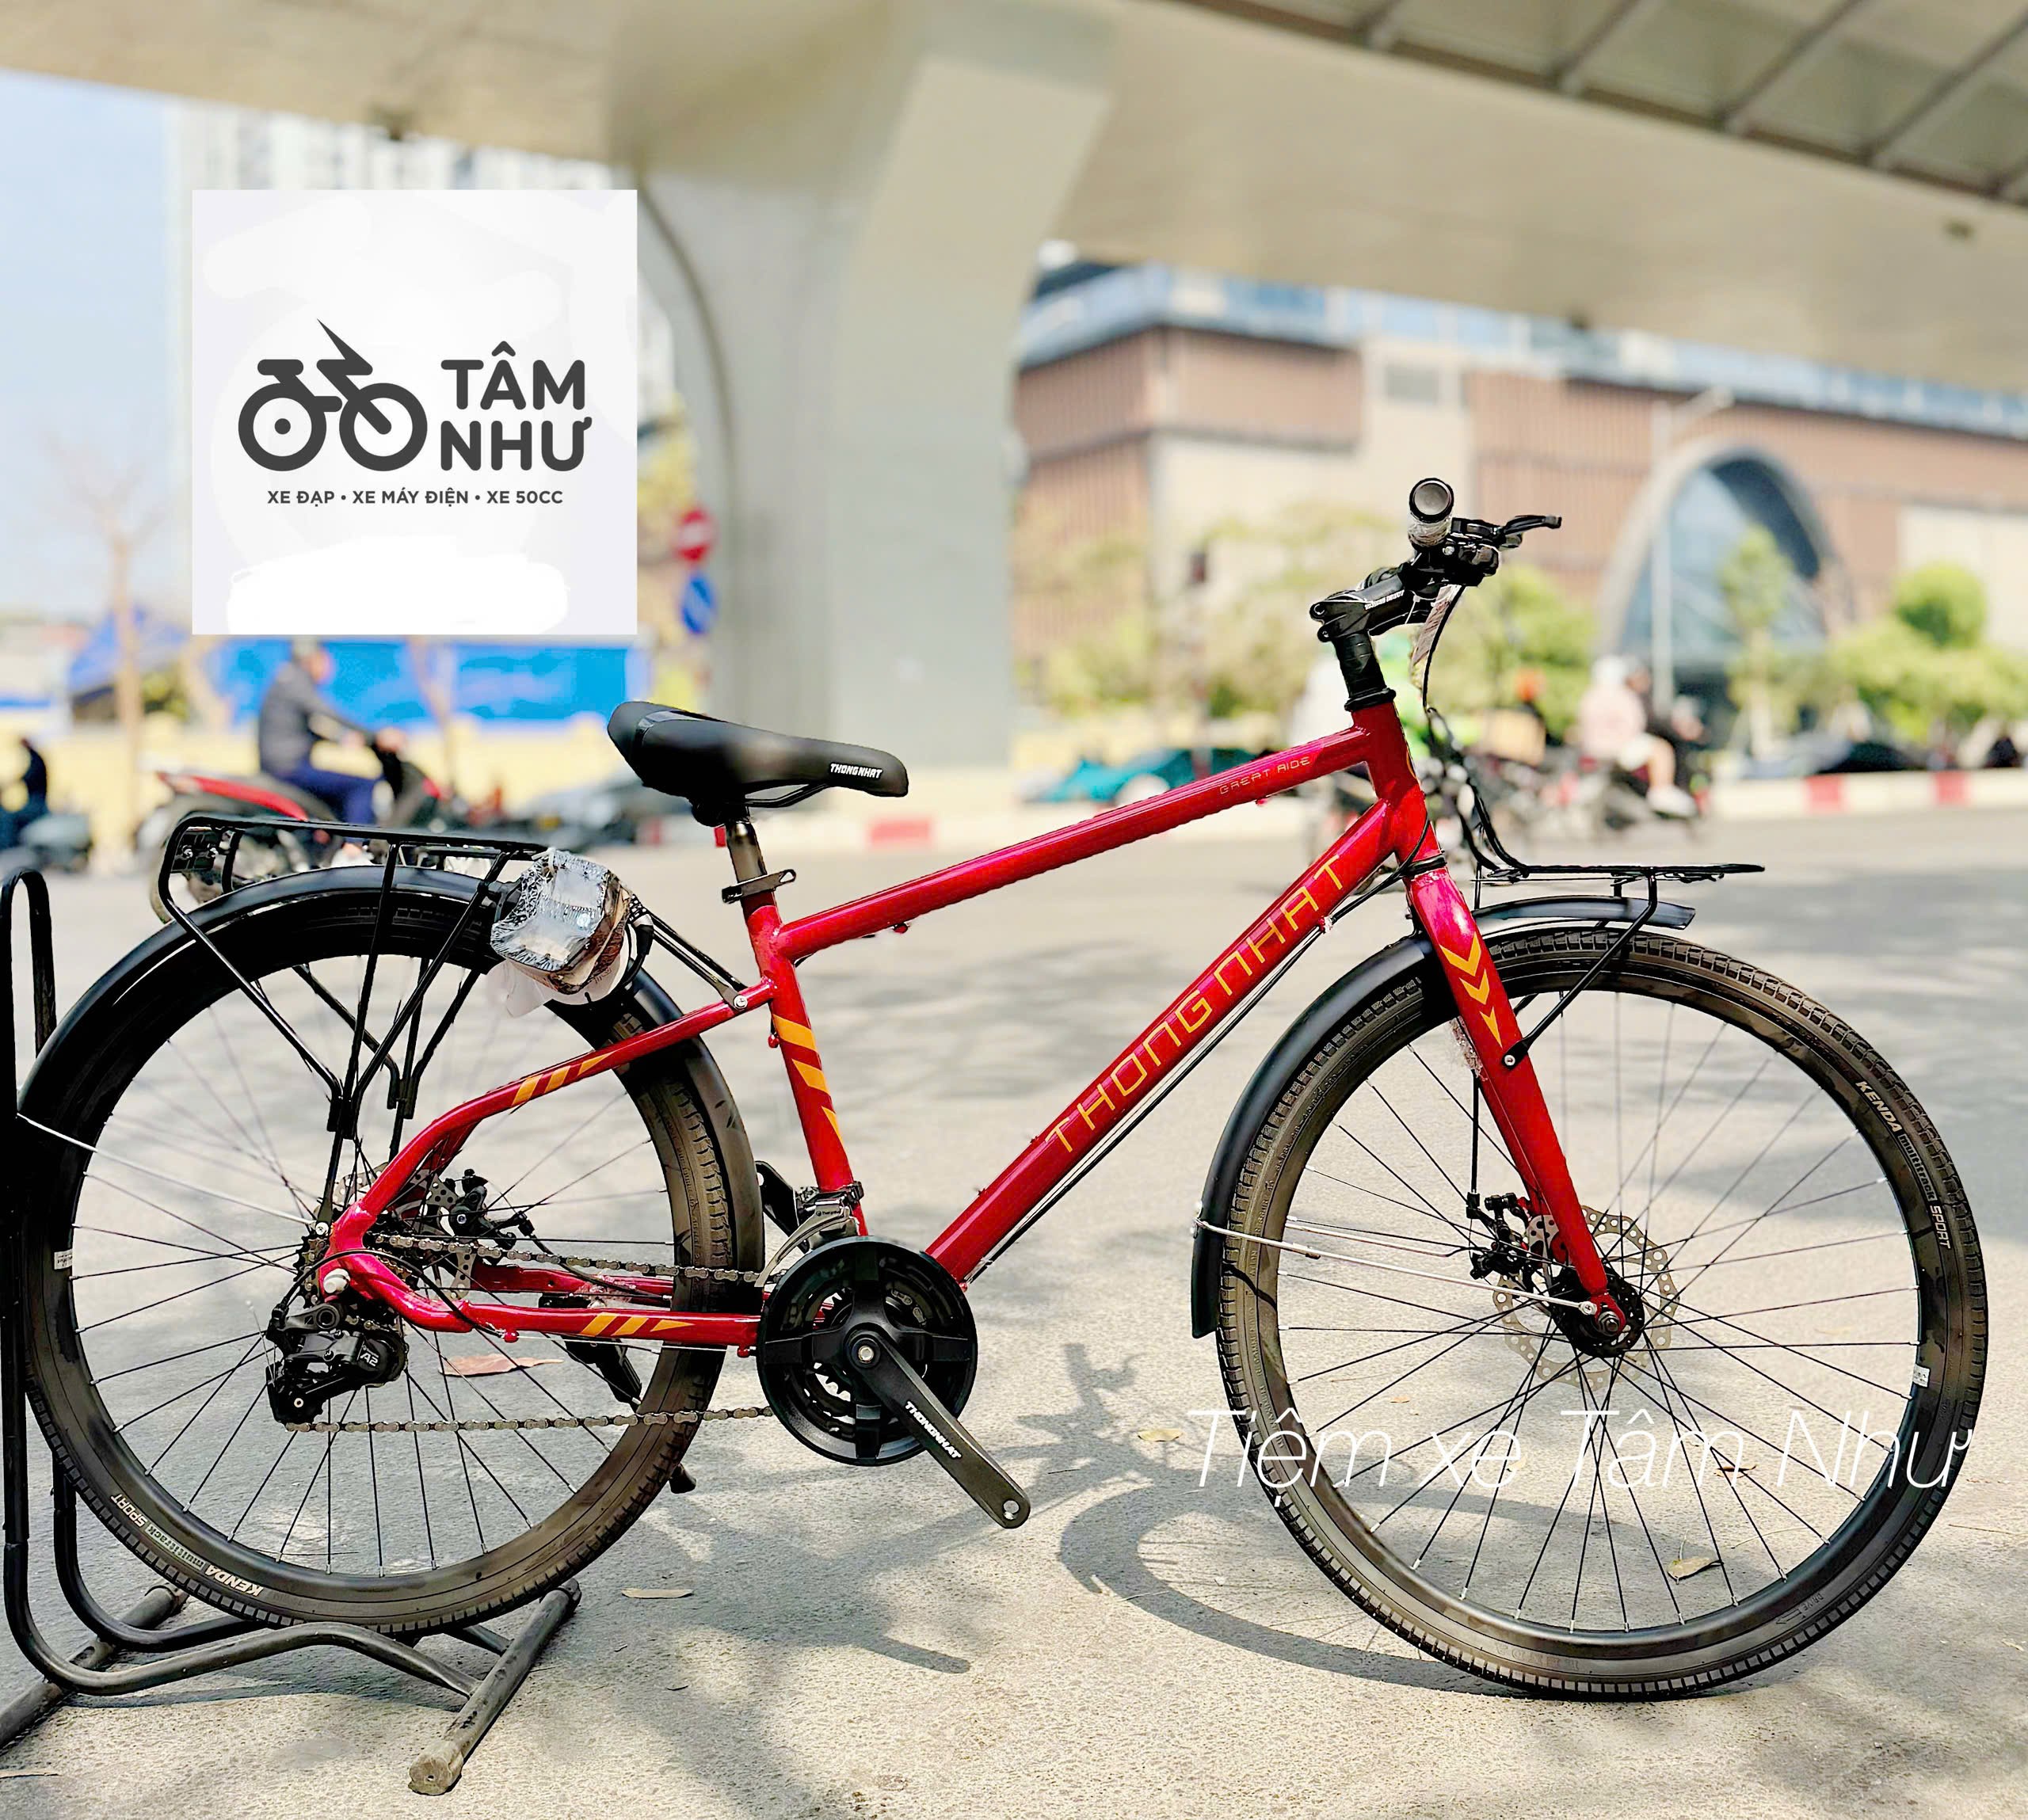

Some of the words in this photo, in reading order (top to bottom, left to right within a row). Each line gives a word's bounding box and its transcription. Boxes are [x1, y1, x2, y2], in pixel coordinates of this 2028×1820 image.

[830, 763, 882, 779] THONGNHAT
[1220, 769, 1271, 794] GREAT
[1276, 756, 1310, 774] RIDE
[1855, 1081, 1903, 1133] KENDA
[1930, 1205, 1951, 1249] SPORT
[360, 1352, 379, 1367] A2
[905, 1401, 962, 1459] THONGNHAT
[111, 1494, 148, 1529] SPORT
[204, 1565, 264, 1597] KENDA
